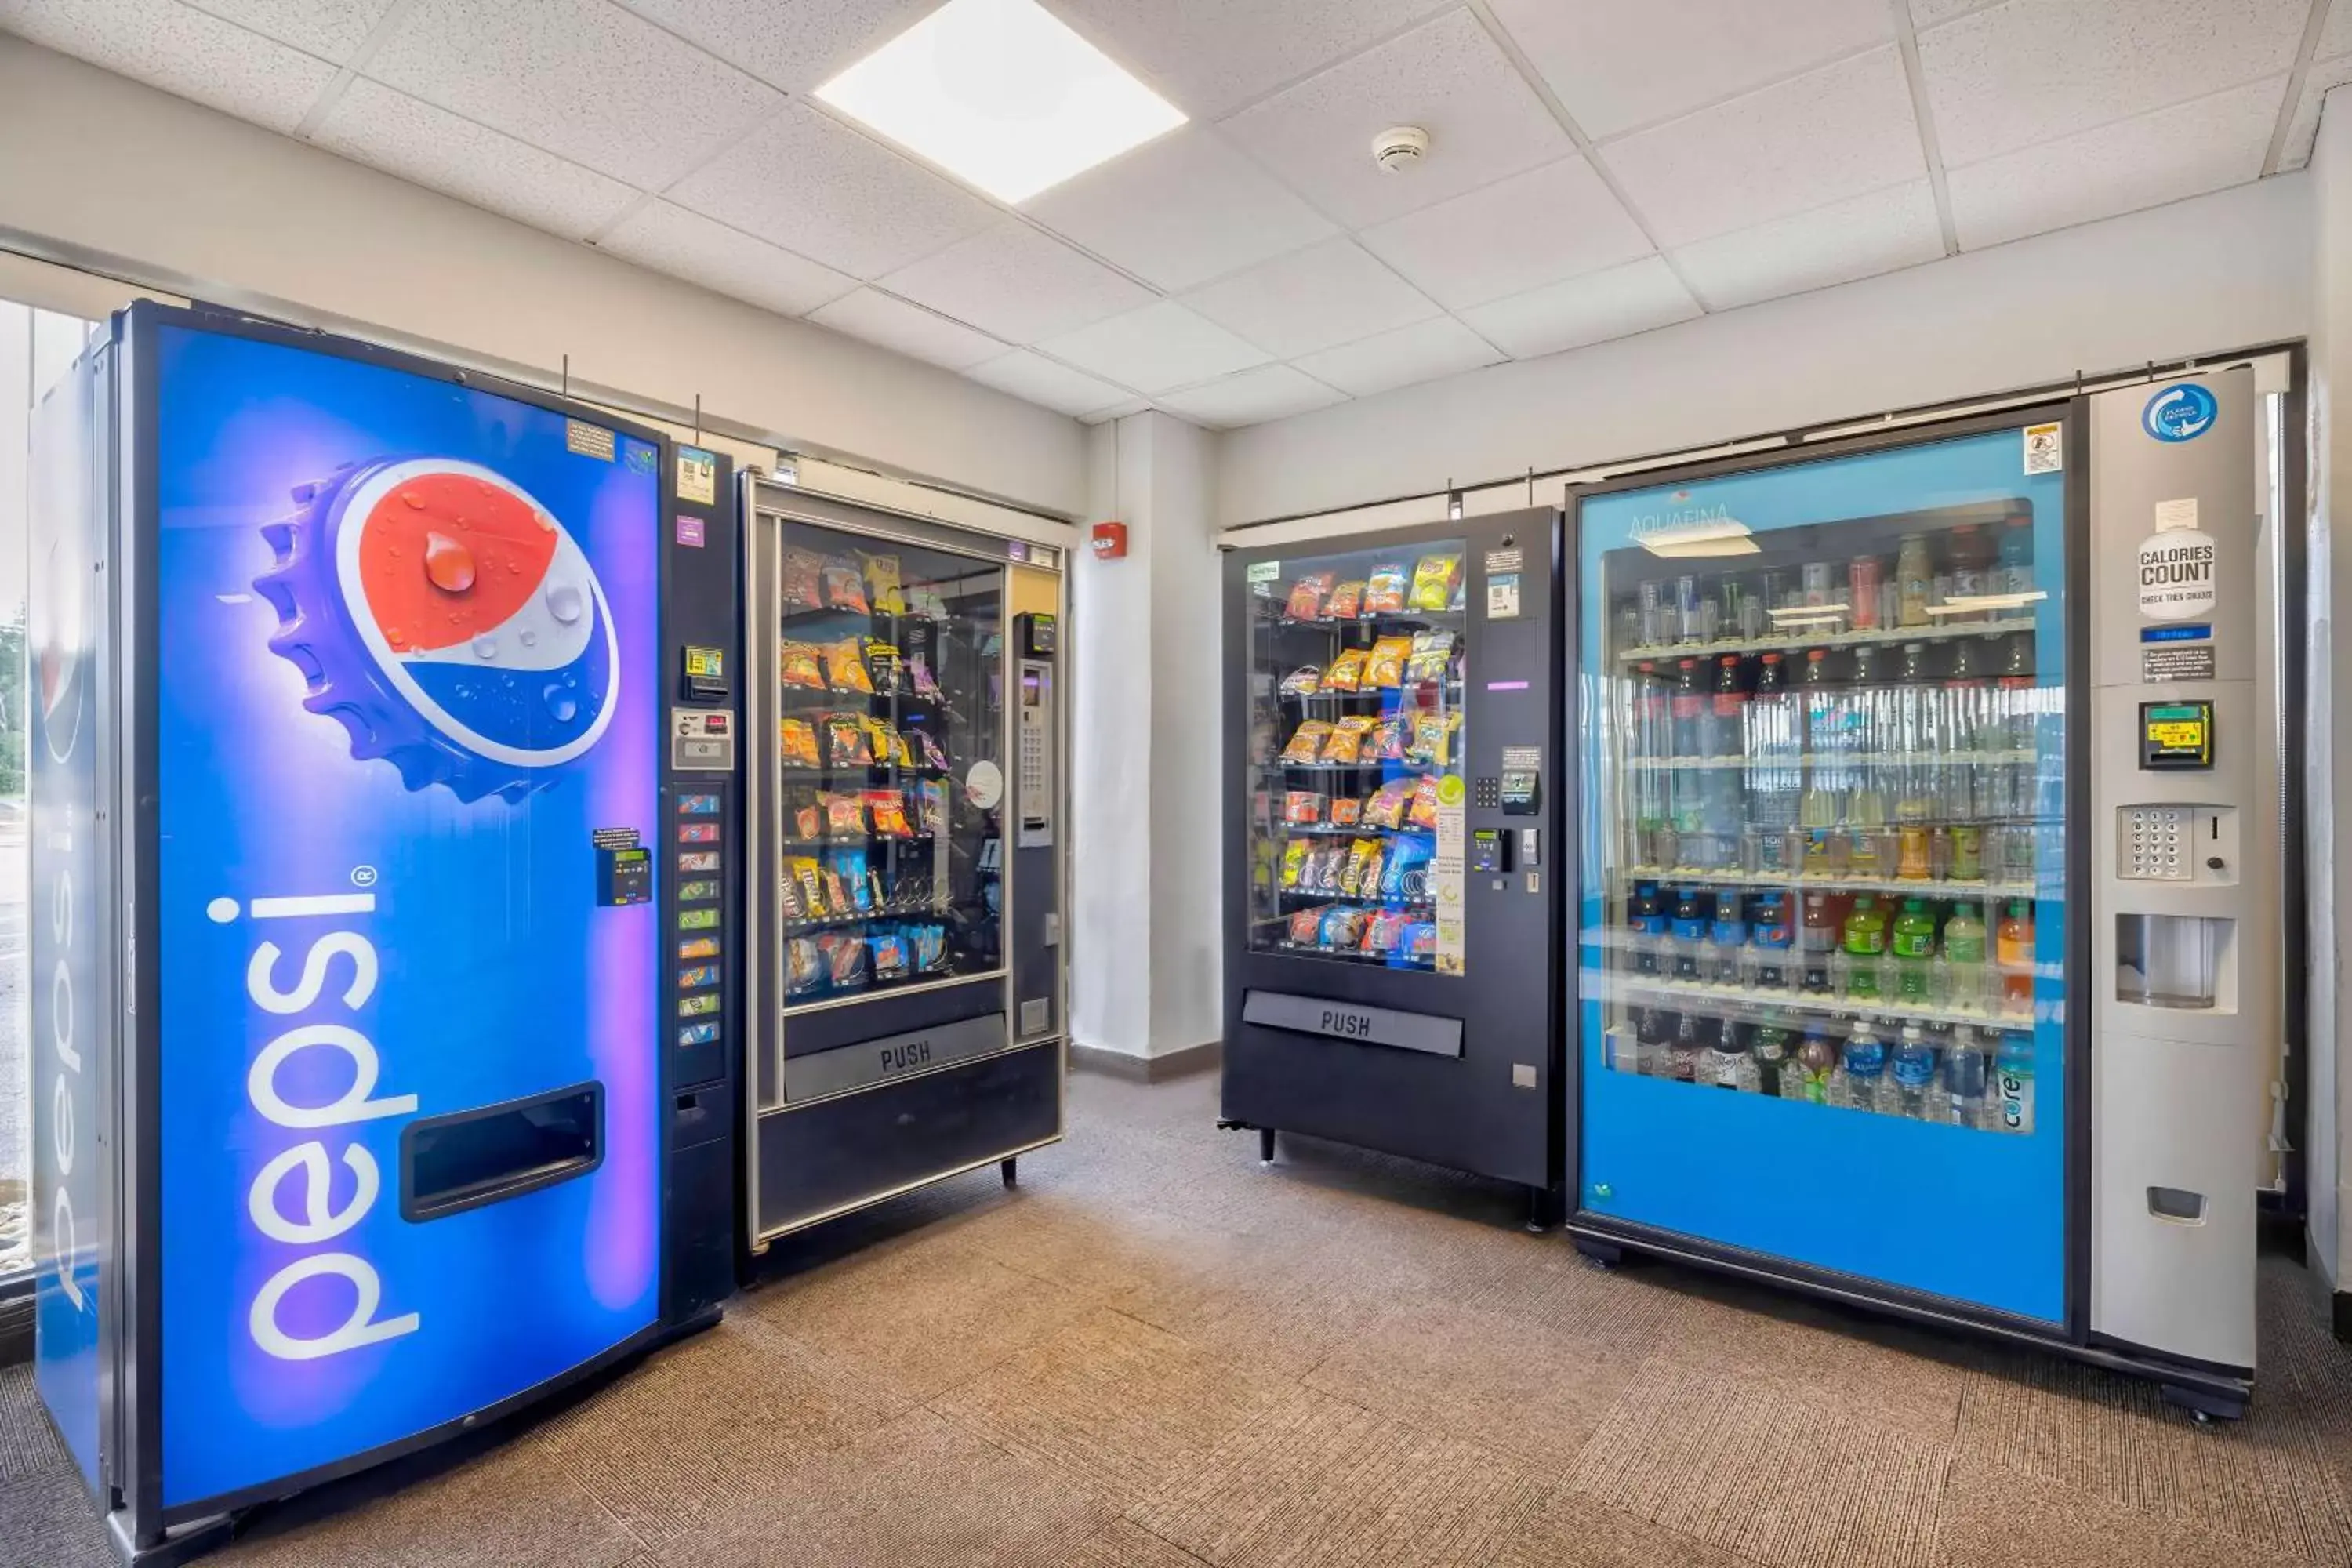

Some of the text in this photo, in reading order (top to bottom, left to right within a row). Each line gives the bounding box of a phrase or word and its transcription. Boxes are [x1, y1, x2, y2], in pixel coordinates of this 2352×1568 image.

[1628, 501, 1730, 539] AQUAFINA
[2141, 546, 2212, 564] CALORIES
[2141, 561, 2212, 585] COUNT
[2142, 594, 2163, 605] CHECK
[2166, 593, 2183, 603] THEN
[1321, 1011, 1370, 1036] PUSH
[46, 826, 82, 1312] pepsi
[880, 1040, 931, 1072] PUSH
[2005, 1076, 2021, 1128] core
[206, 893, 419, 1360] pepsi
